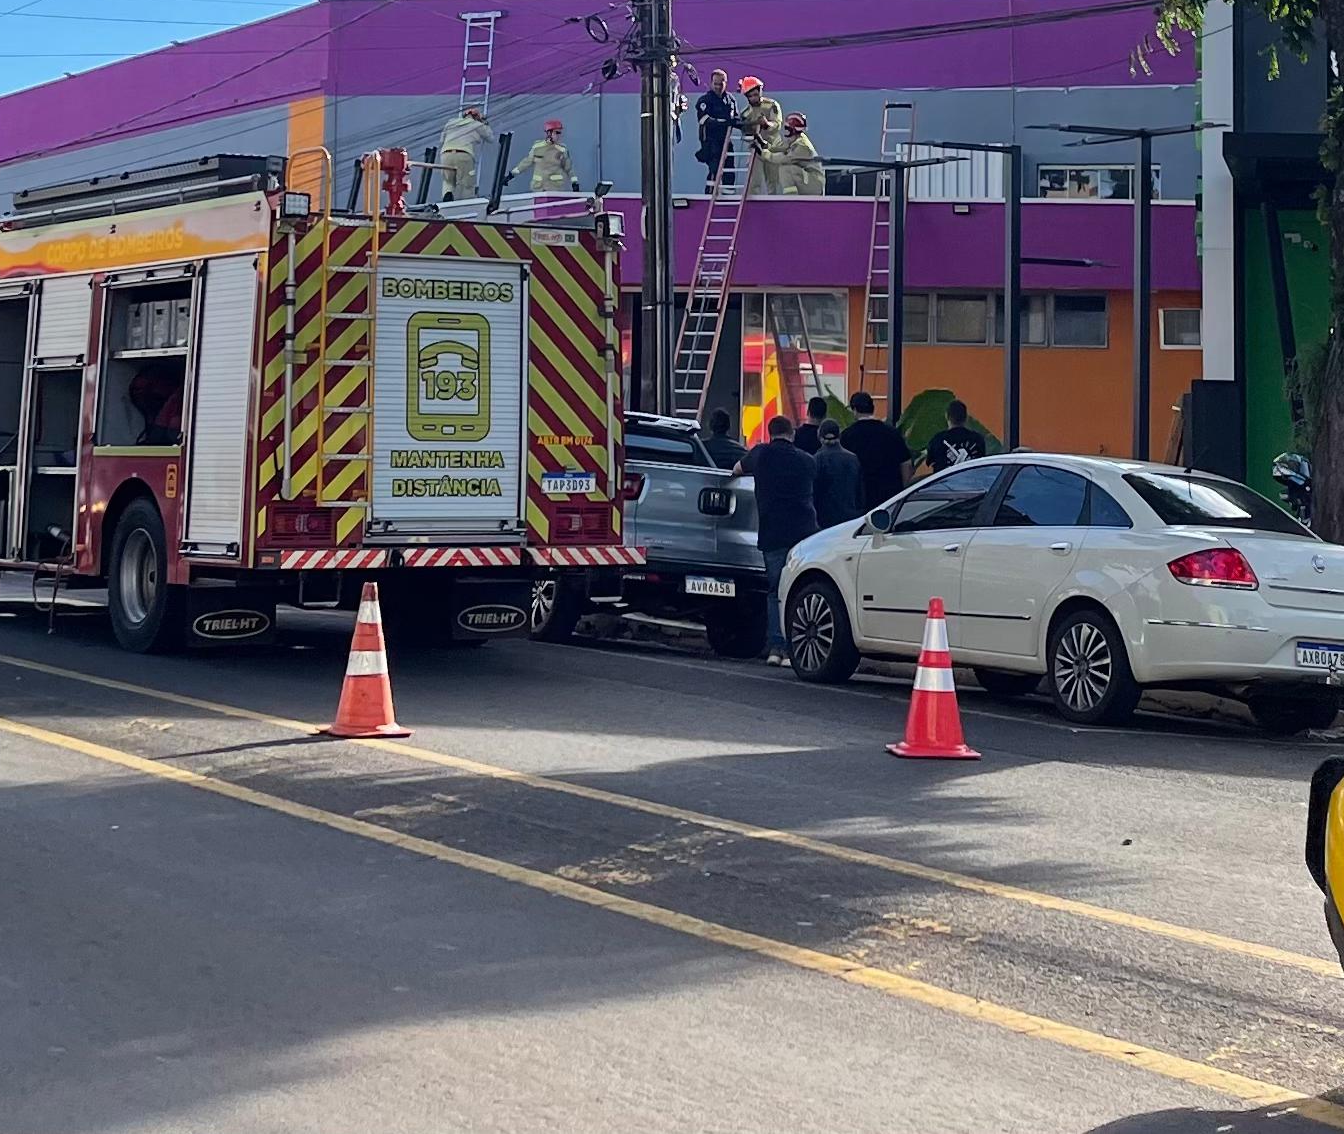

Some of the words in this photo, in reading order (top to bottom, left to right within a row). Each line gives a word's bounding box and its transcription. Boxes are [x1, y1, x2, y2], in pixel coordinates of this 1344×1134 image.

[382, 277, 514, 302] BOMBEIROS
[421, 371, 477, 401] 193
[391, 450, 505, 468] MANTENHA
[392, 475, 502, 497] DISTÂNCIA
[547, 479, 591, 491] TAP3D93
[691, 581, 731, 594] AVR6A58
[203, 618, 259, 631] TRIEL-HT
[467, 613, 518, 625] TRIEL-HT
